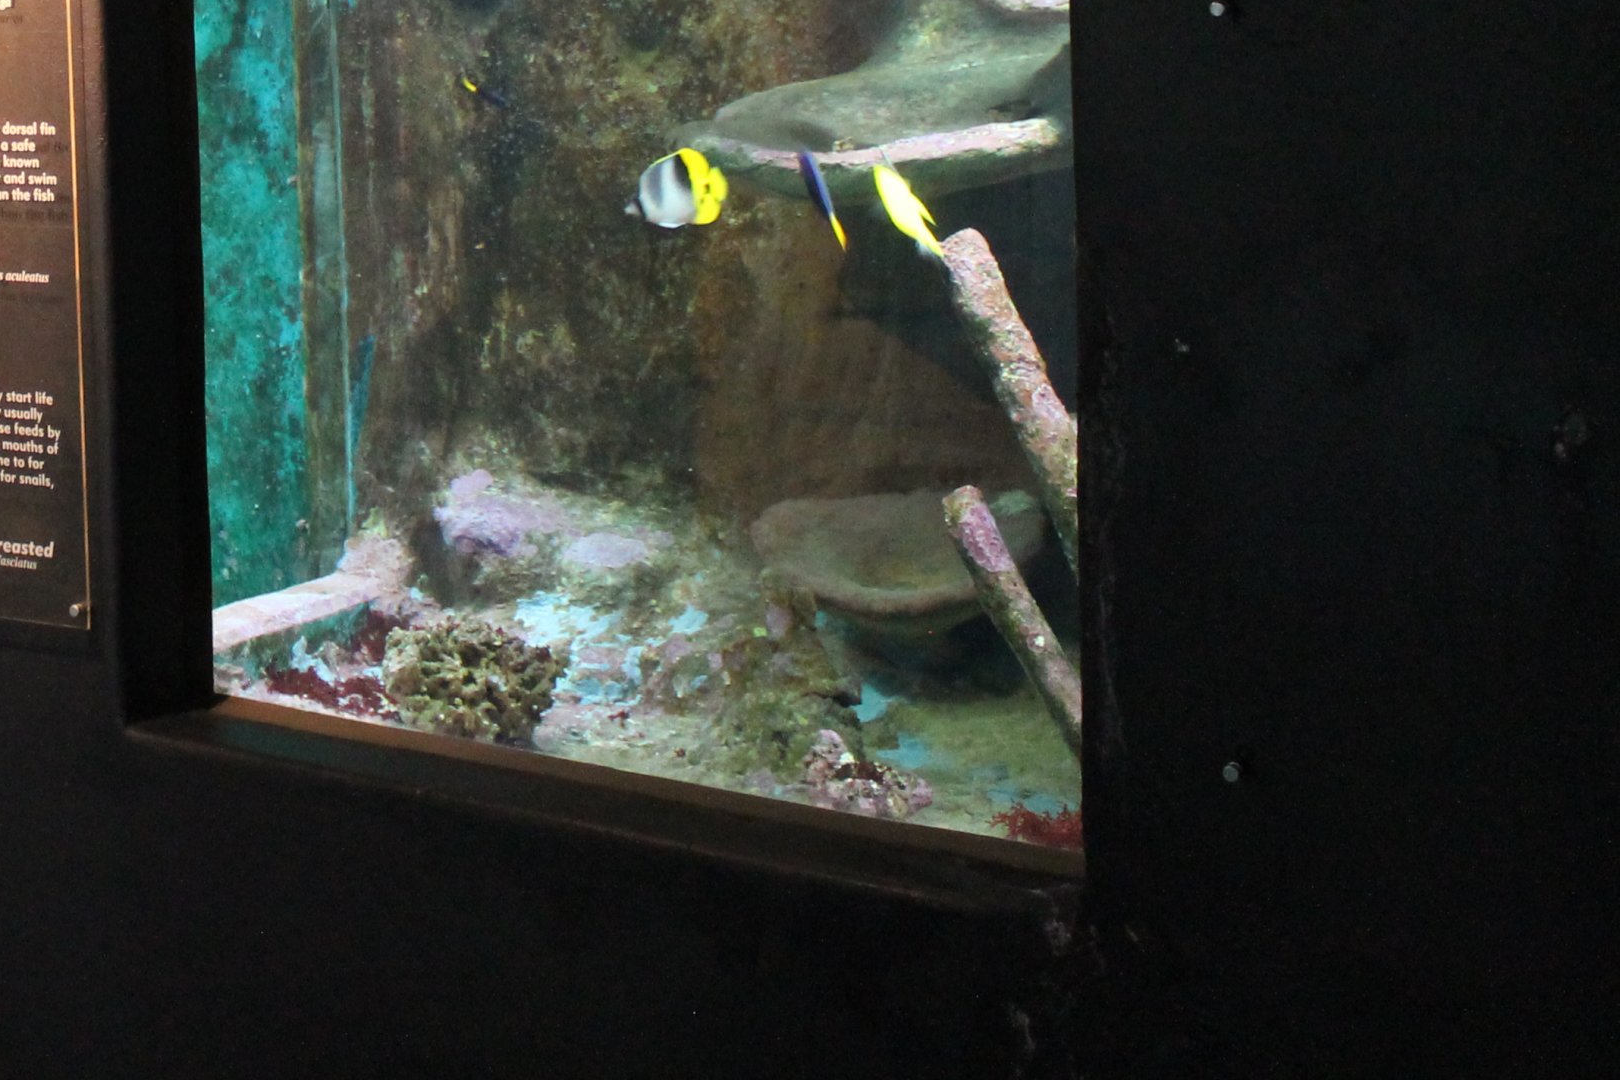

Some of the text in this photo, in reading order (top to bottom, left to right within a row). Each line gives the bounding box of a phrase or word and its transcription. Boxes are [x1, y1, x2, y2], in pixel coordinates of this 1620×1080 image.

[2, 122, 37, 134] dorsal
[40, 122, 56, 135] fin
[5, 270, 49, 282] aculeatus
[6, 391, 32, 403] start
[35, 393, 53, 405] life
[5, 409, 43, 424] usually
[14, 424, 44, 437] feeds
[48, 427, 60, 442] by
[13, 456, 25, 467] to
[28, 457, 44, 469] for
[0, 471, 16, 483] for
[20, 474, 54, 490] snails,
